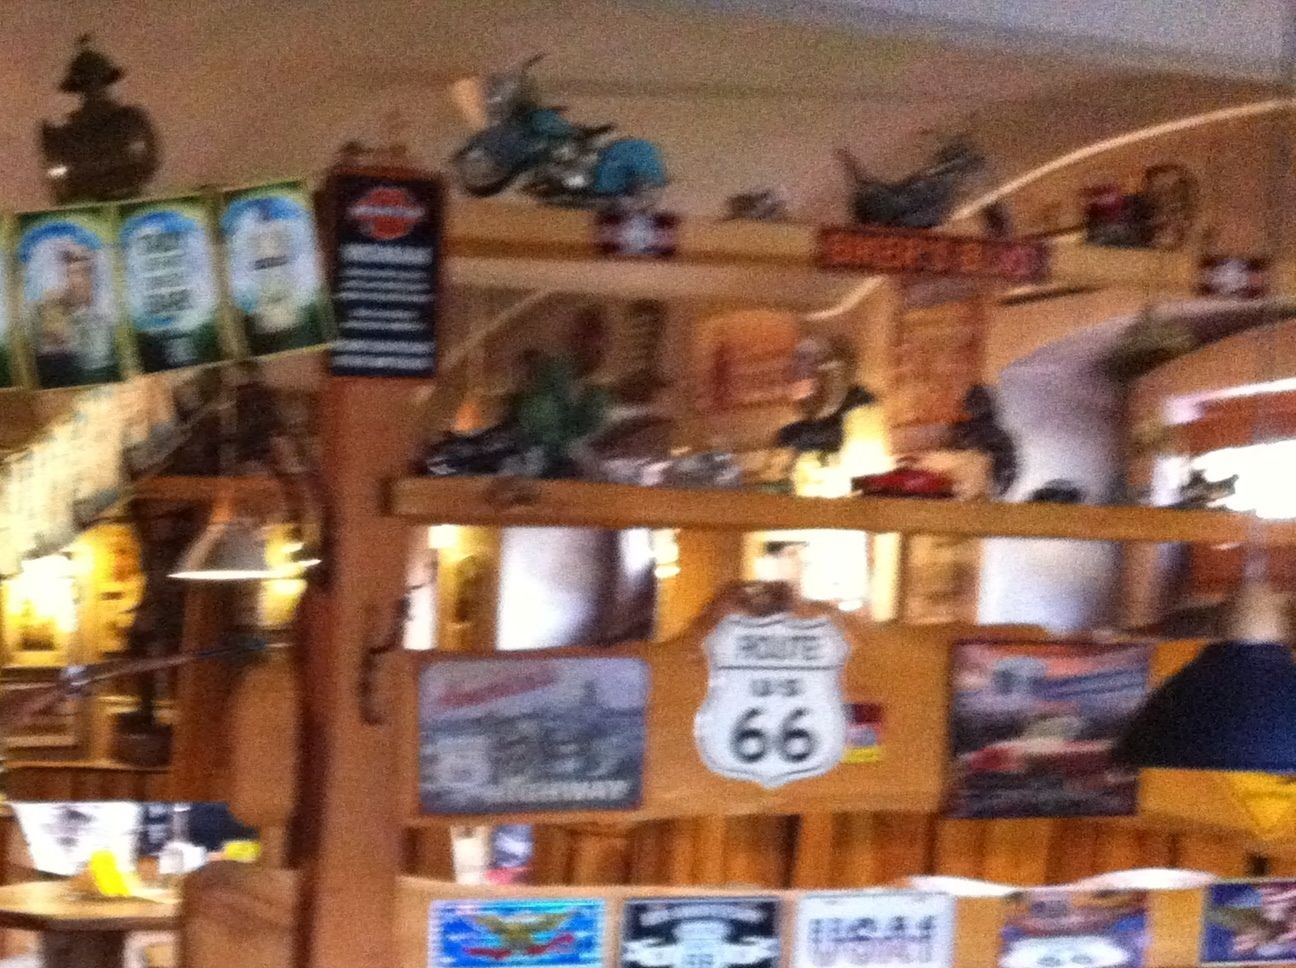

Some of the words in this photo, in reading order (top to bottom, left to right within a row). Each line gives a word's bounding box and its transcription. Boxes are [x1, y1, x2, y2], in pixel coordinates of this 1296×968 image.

[736, 634, 822, 661] ROUTE
[750, 678, 800, 697] US
[730, 706, 819, 764] 66
